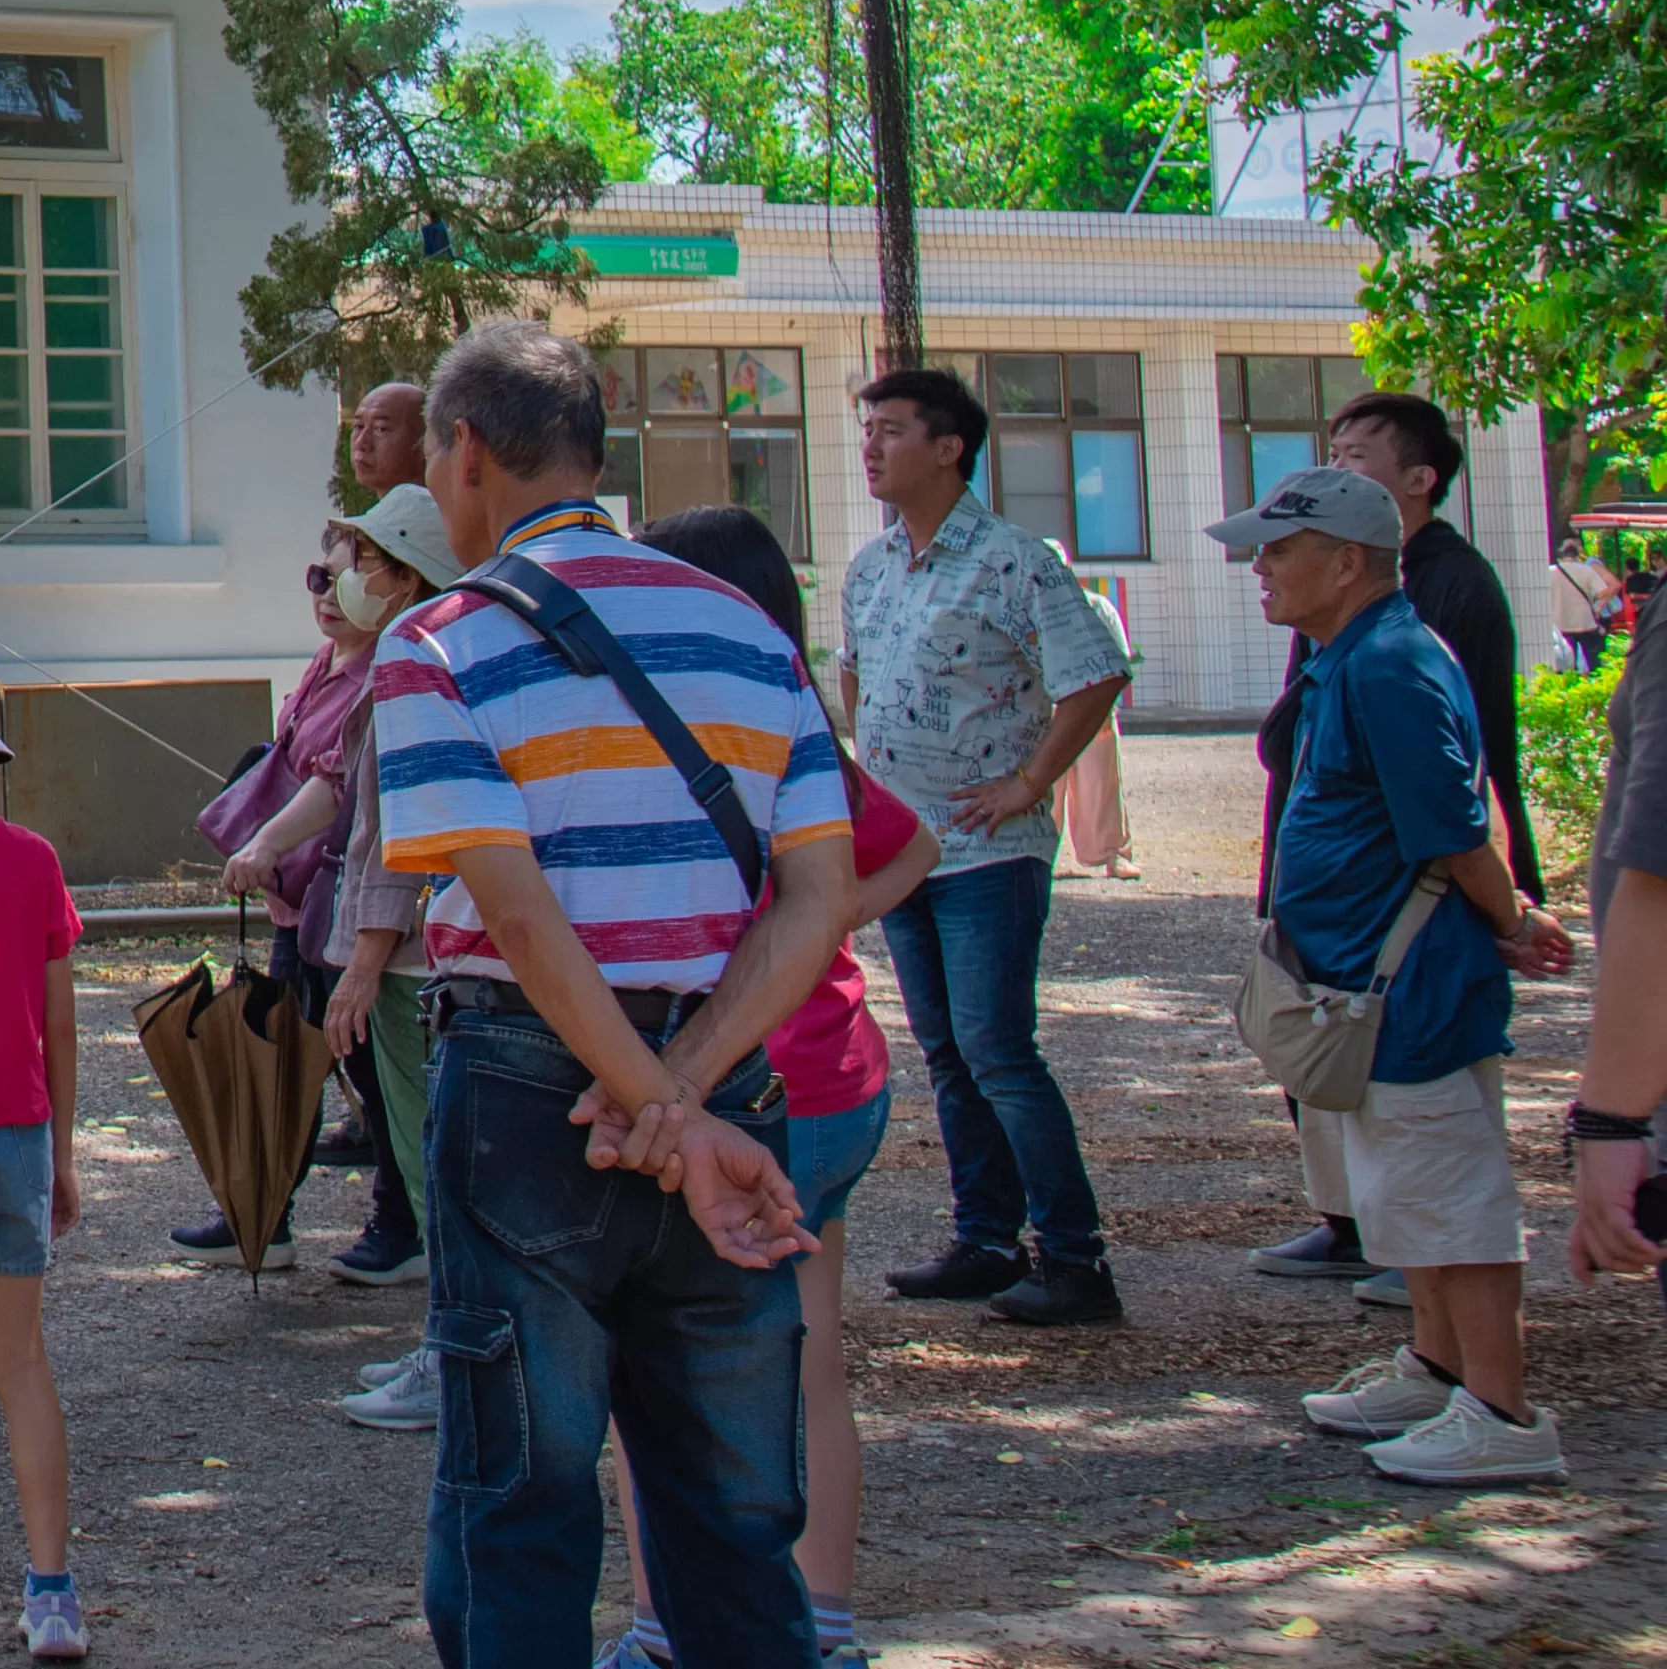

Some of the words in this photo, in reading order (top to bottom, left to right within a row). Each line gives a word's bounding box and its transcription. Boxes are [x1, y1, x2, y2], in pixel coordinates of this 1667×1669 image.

[1273, 491, 1320, 510] NIKE
[922, 683, 951, 699] SKY
[921, 697, 951, 716] THE
